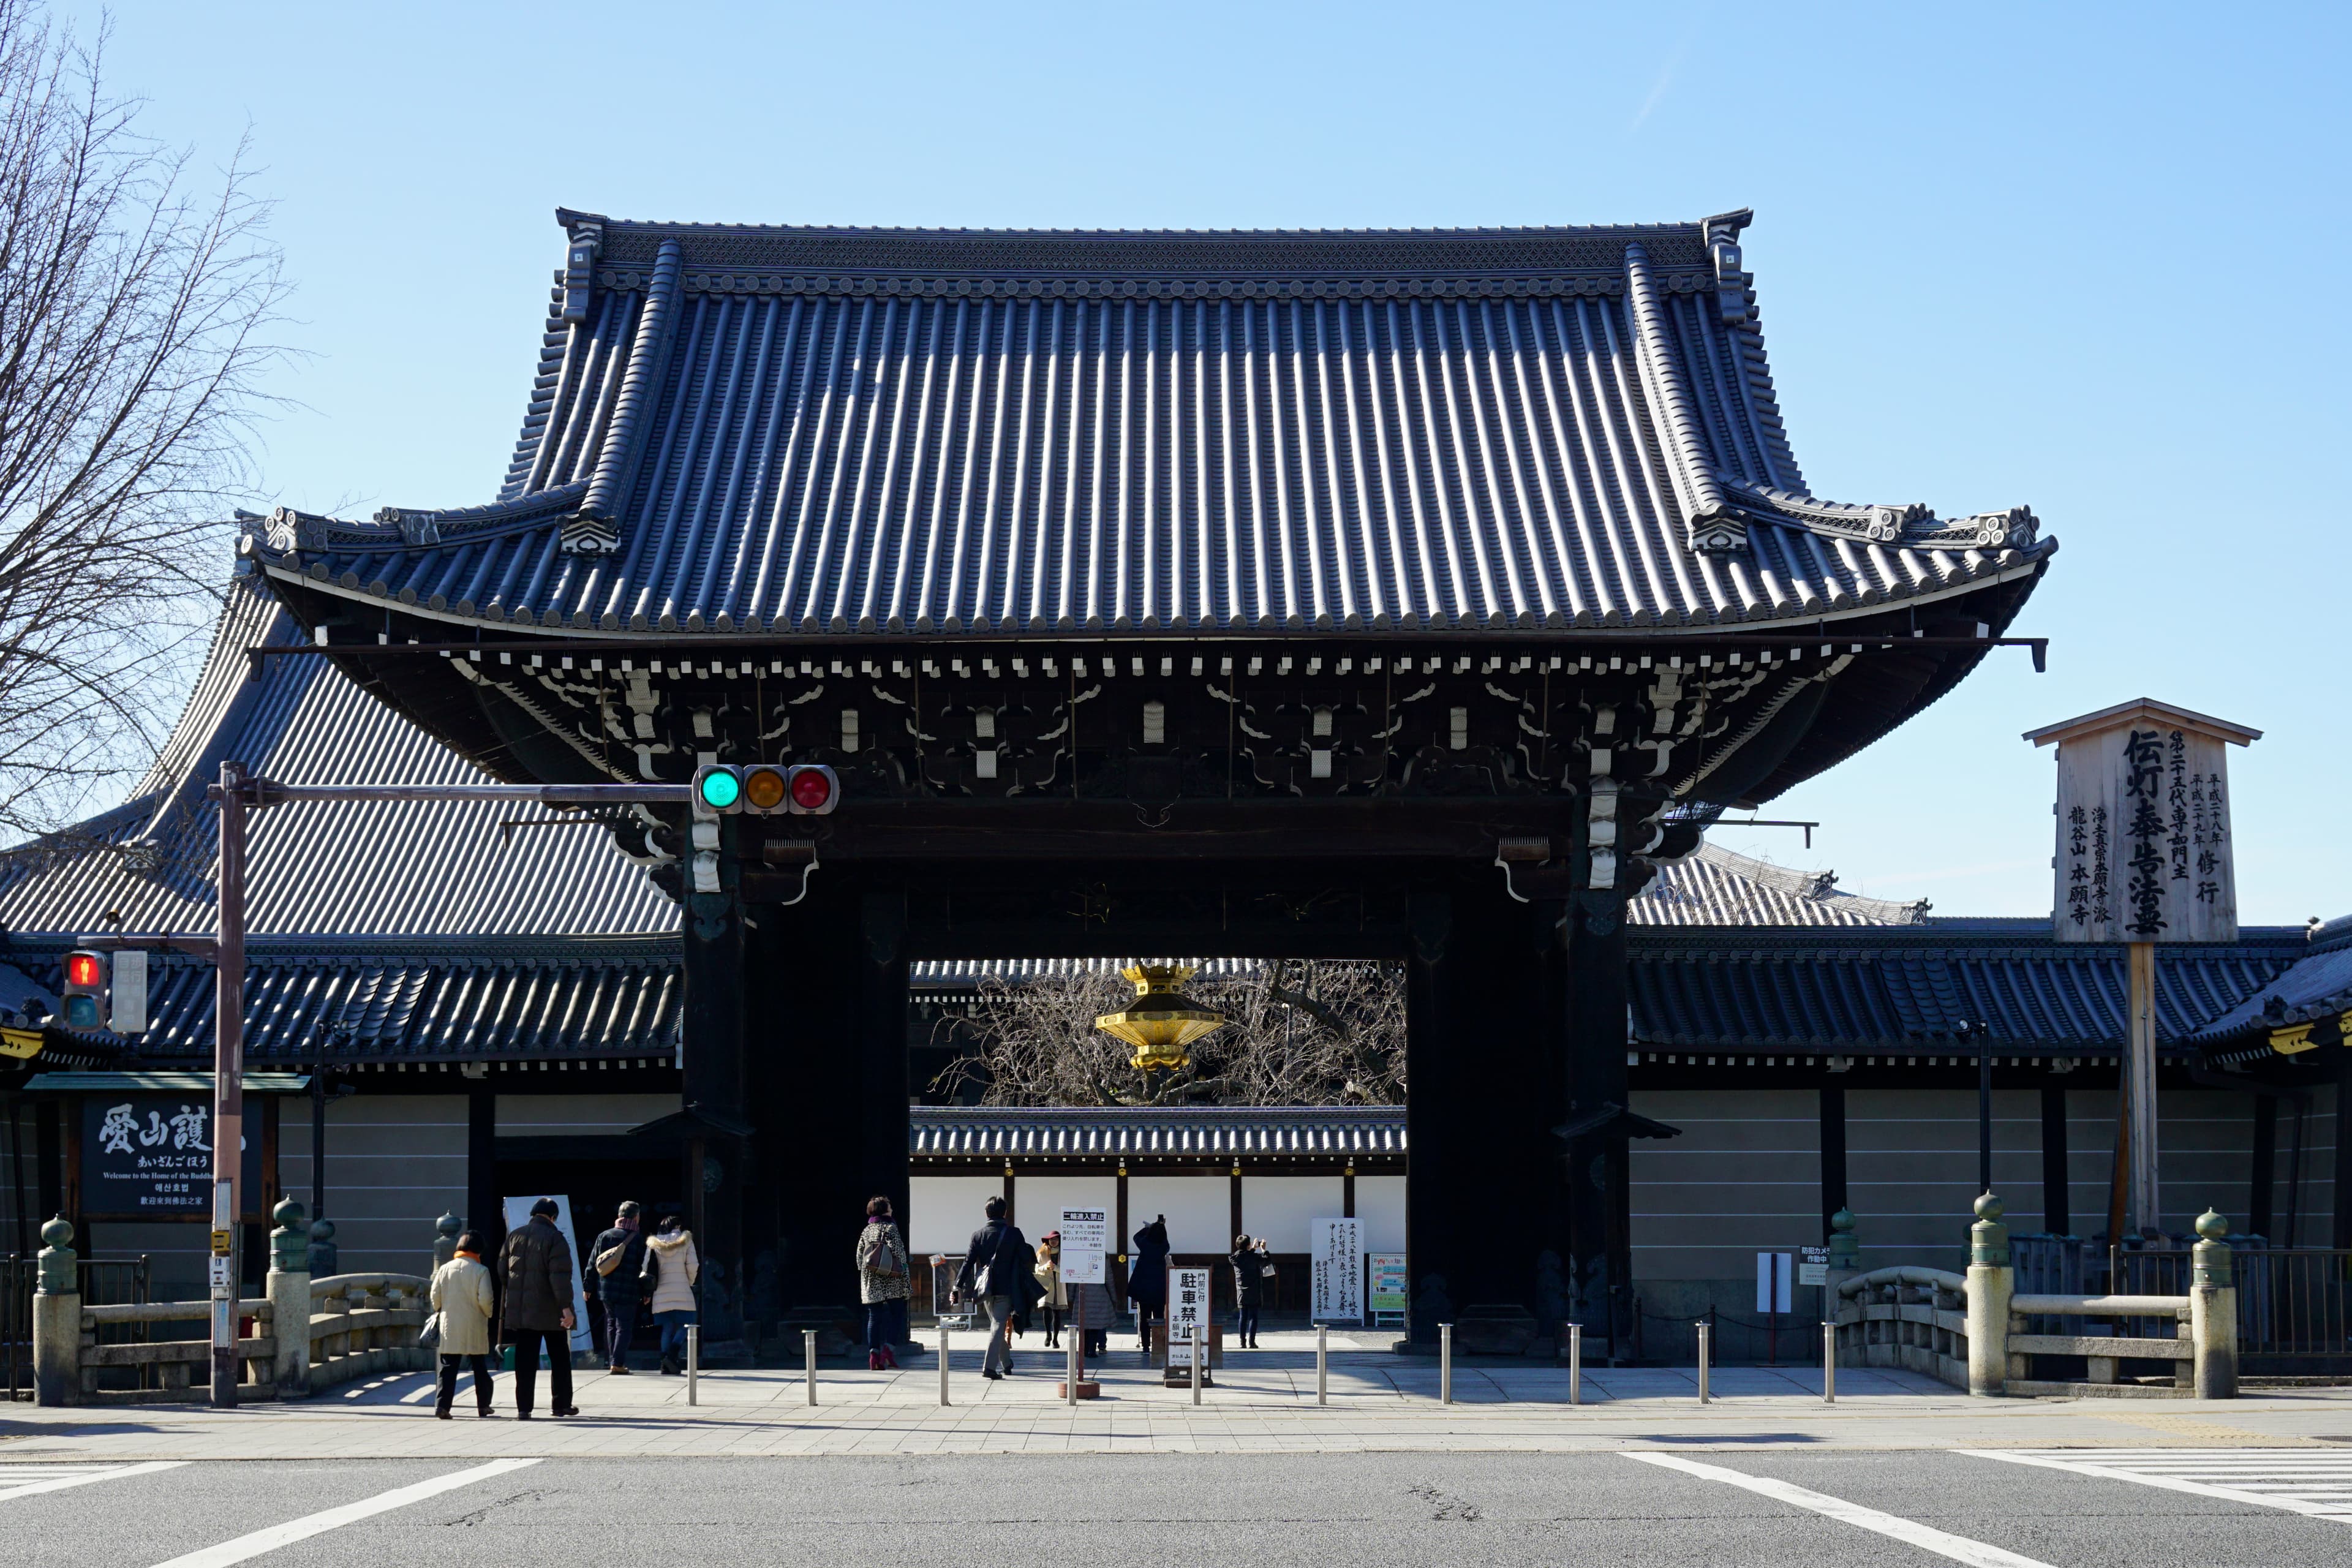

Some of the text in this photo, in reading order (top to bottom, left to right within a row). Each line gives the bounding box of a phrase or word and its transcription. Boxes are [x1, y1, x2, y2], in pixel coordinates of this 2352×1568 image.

[2123, 730, 2168, 934] 伝灯奉告法要
[2167, 730, 2190, 880] 第二十五代専如門主
[2190, 774, 2206, 848] 平成二十九年
[2207, 774, 2224, 847] 平成二十八年
[2068, 804, 2090, 926] 龍谷山本願寺
[2091, 806, 2113, 924] 浄土真宗本願寺派
[2196, 850, 2220, 904] 修行
[99, 1103, 246, 1154] 愛山護
[137, 1155, 208, 1168] あいざんごほう
[155, 1183, 189, 1192] 애산호법
[140, 1196, 203, 1205] 歡迎來到佛法之家
[1063, 1212, 1104, 1221] 二輪進入禁止
[1180, 1273, 1196, 1338] 駐車禁止
